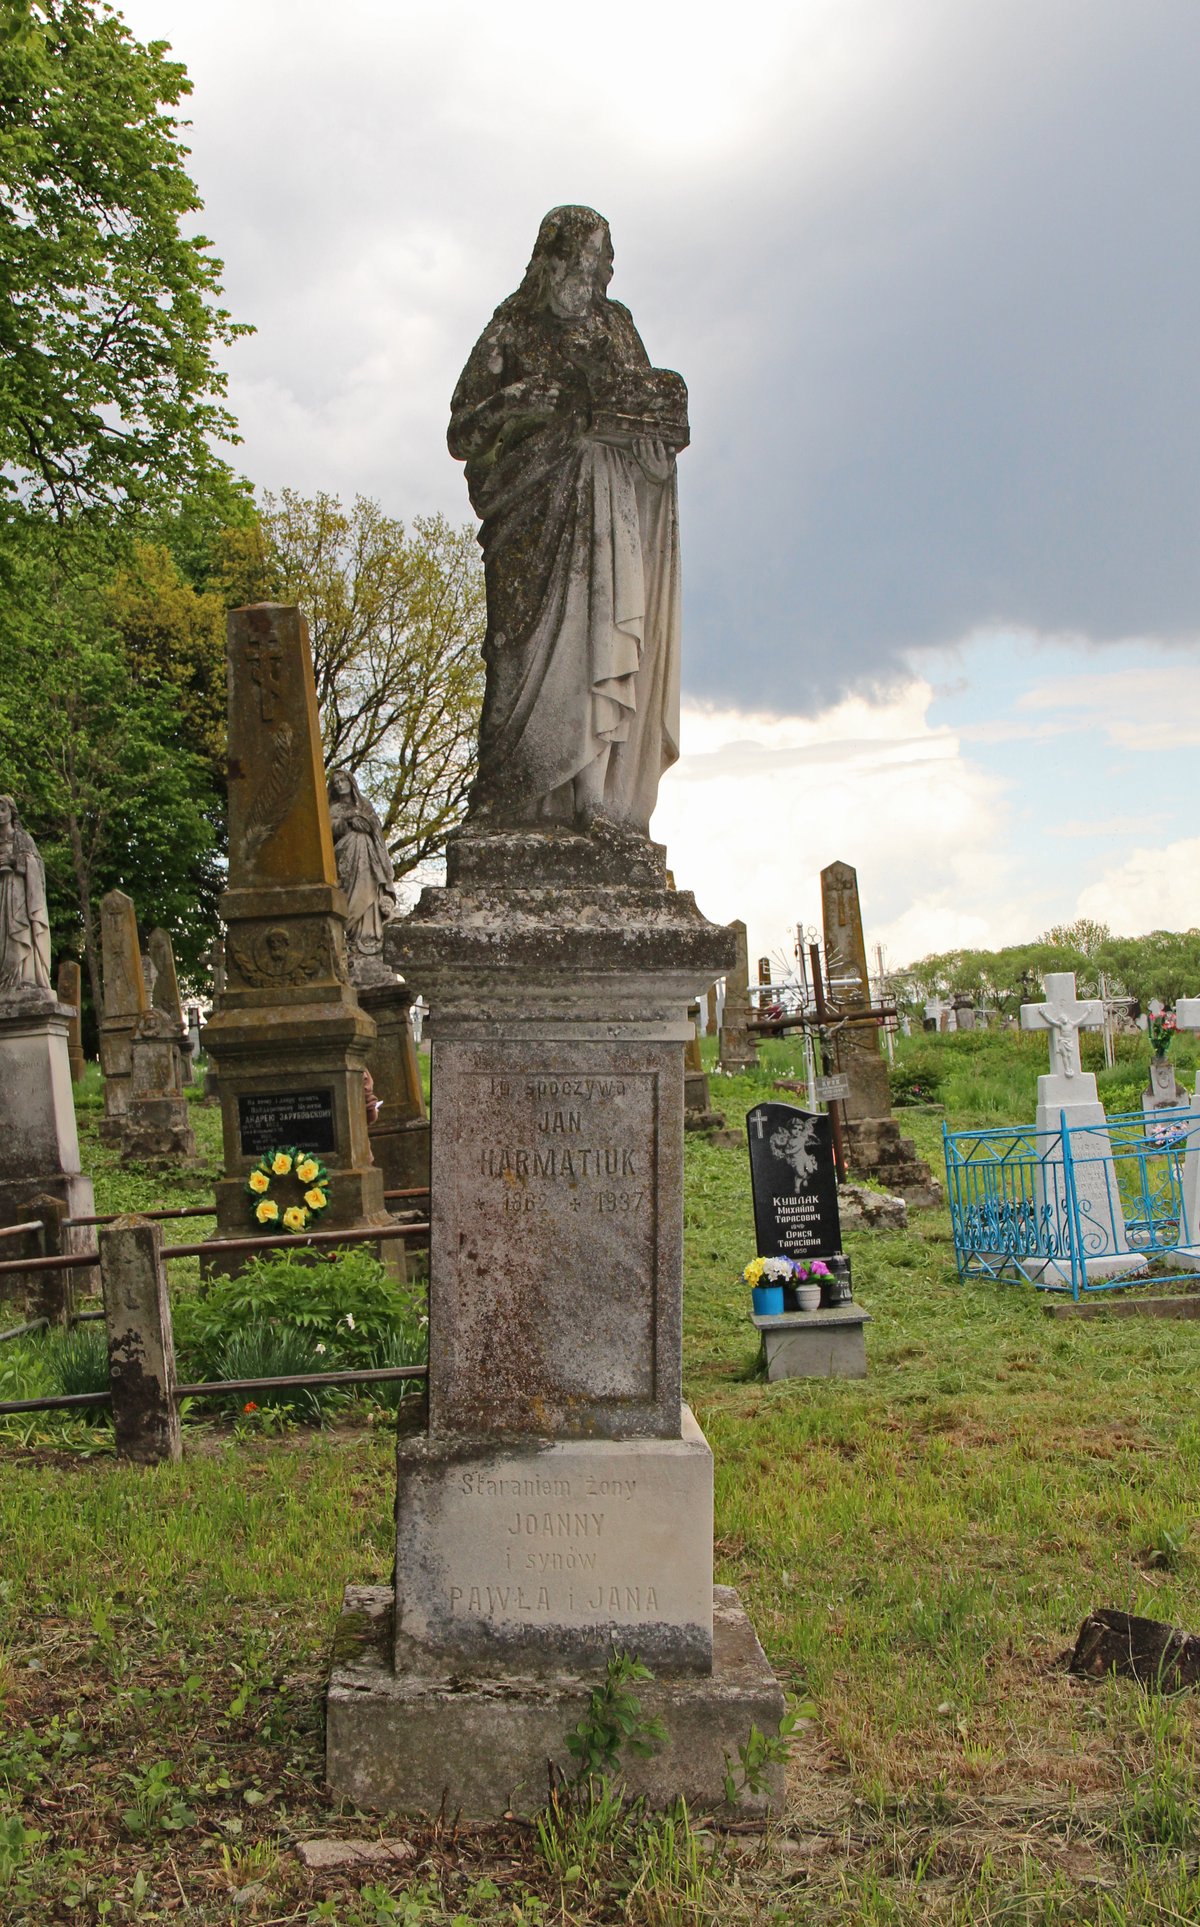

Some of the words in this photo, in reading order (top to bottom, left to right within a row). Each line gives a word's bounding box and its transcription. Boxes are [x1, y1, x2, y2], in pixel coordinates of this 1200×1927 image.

[525, 1079, 626, 1102] spoczywa
[538, 1111, 582, 1133] JAN
[480, 1149, 637, 1178] HARMATIUK
[597, 1190, 644, 1214] 1937
[773, 1194, 820, 1206] КУШЛАК
[462, 1473, 571, 1497] Staraniem
[586, 1475, 637, 1501] żony
[507, 1512, 605, 1537] JOANNY
[506, 1547, 512, 1571] i
[525, 1546, 598, 1574] synów
[450, 1585, 551, 1613] PAWŁA
[568, 1586, 574, 1611] i
[588, 1585, 660, 1612] JANA
